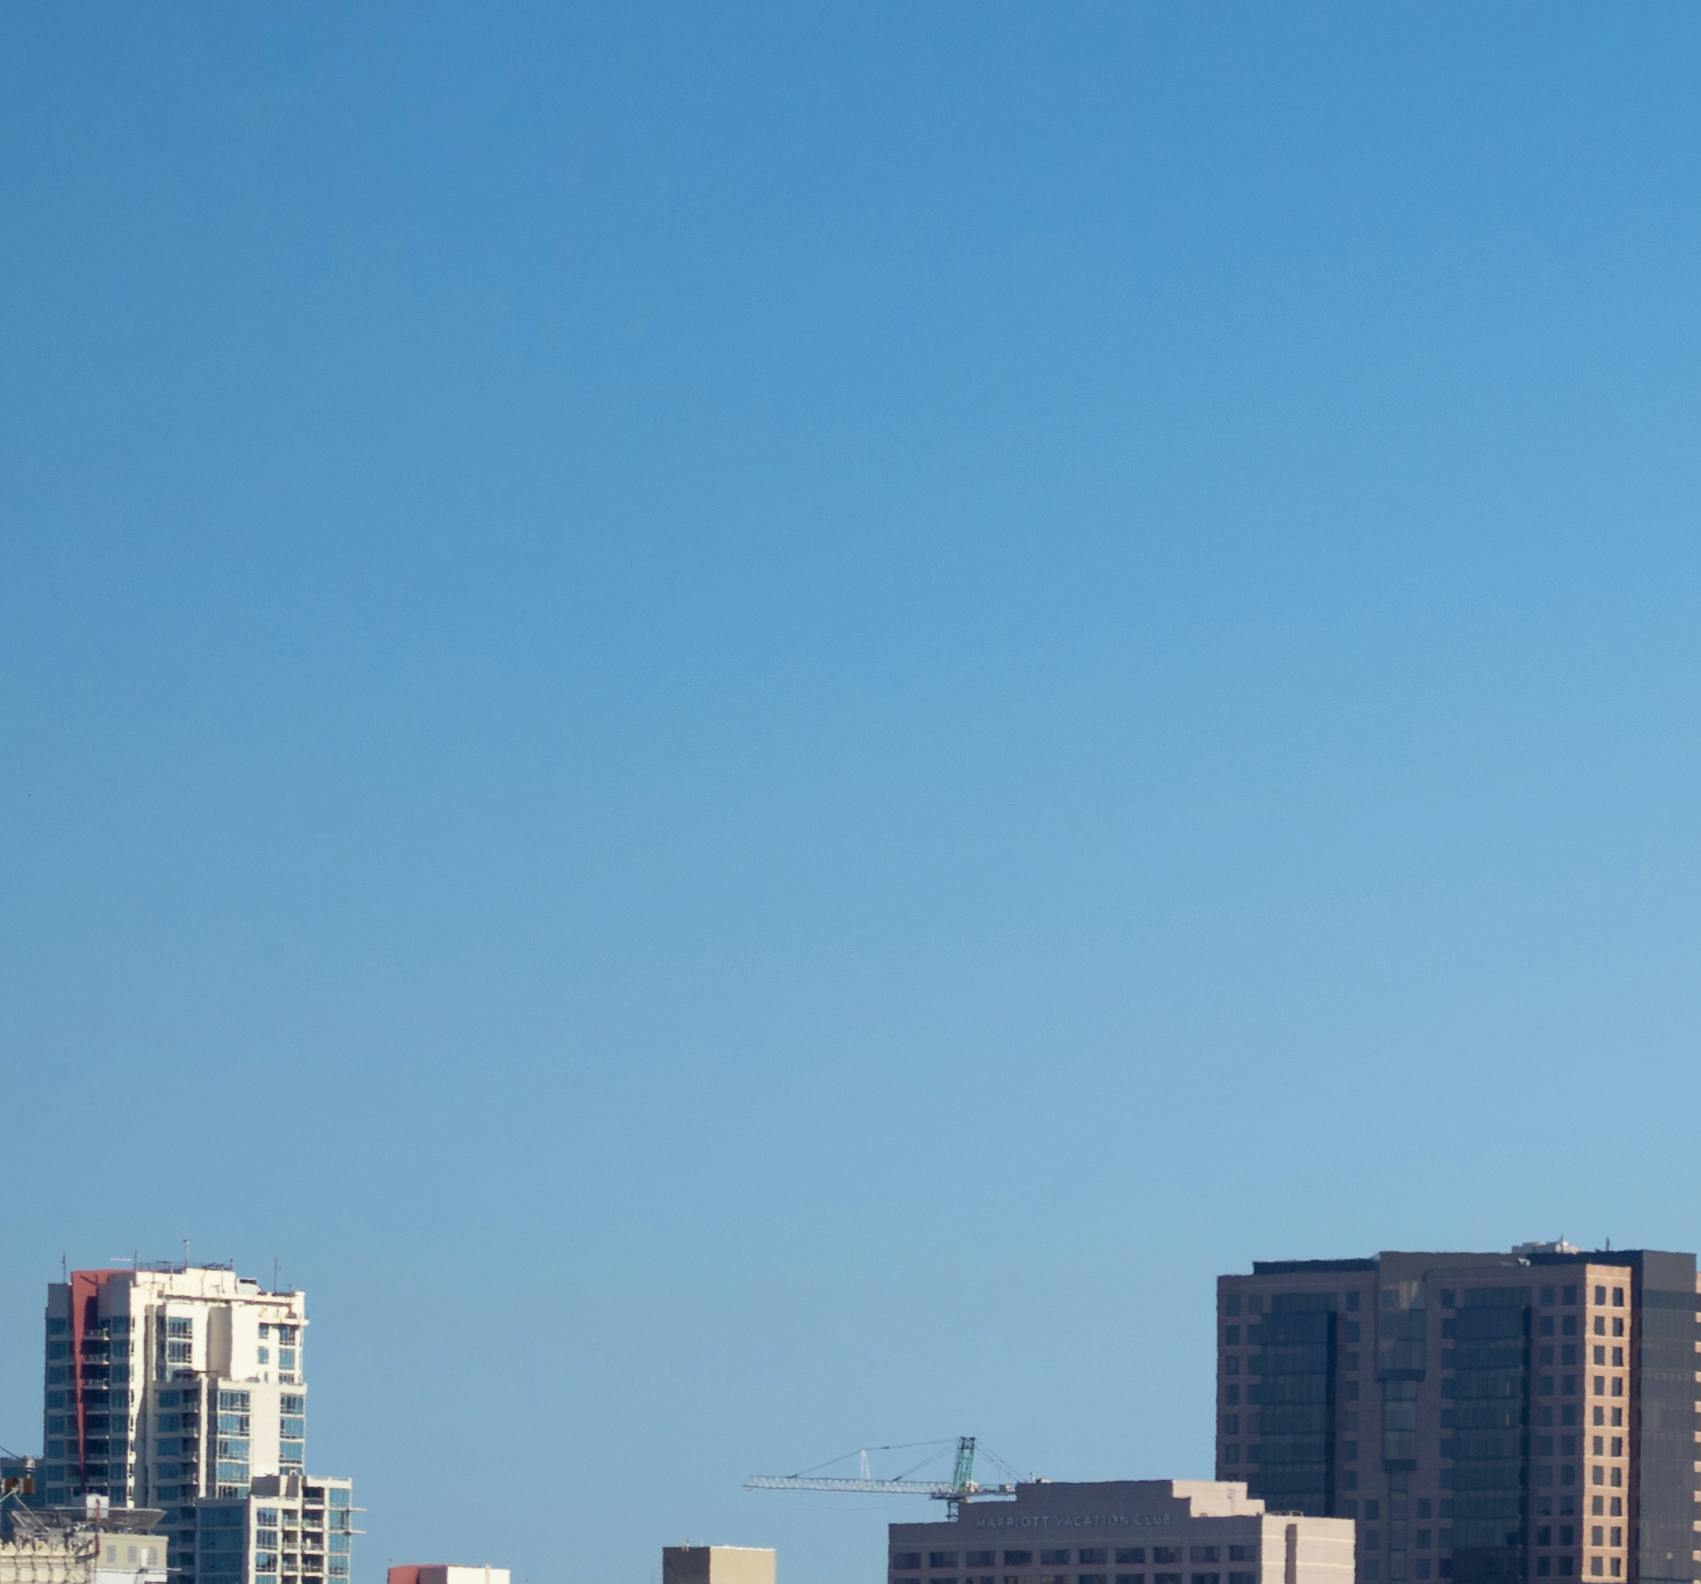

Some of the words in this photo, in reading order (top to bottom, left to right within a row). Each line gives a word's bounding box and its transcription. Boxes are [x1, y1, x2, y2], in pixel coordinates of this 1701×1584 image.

[976, 1515, 1048, 1528] MARRIOTT
[1056, 1514, 1129, 1527] VACATION
[1135, 1513, 1171, 1526] CLUB
